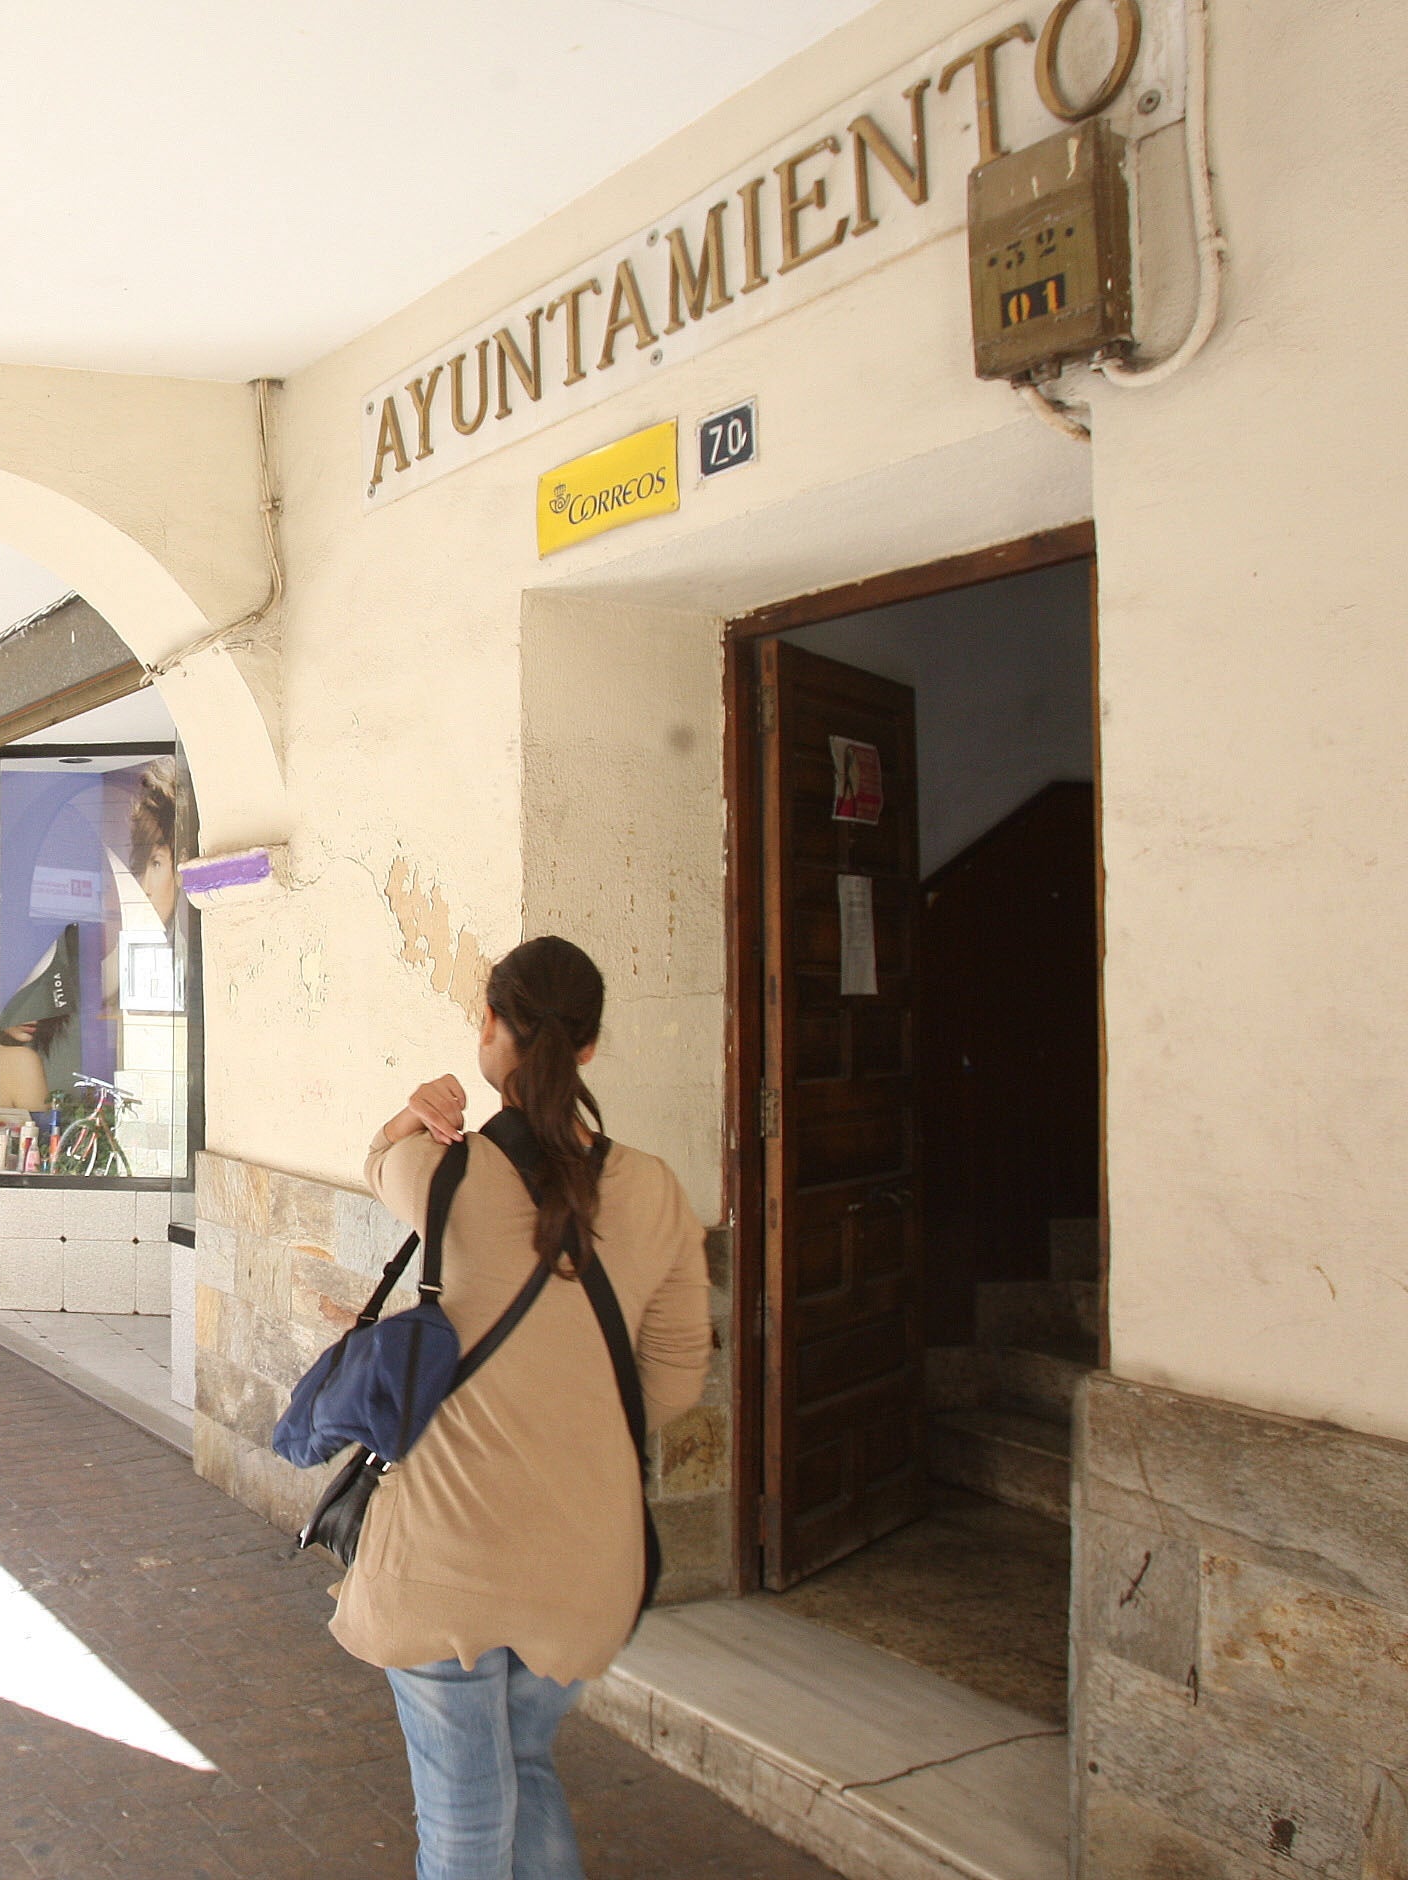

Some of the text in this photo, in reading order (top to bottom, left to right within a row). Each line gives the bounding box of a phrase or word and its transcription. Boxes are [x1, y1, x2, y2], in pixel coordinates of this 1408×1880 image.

[370, 0, 1141, 486] AYUNTAMIENTO
[1007, 279, 1060, 324] 01
[568, 466, 667, 525] CORREOS
